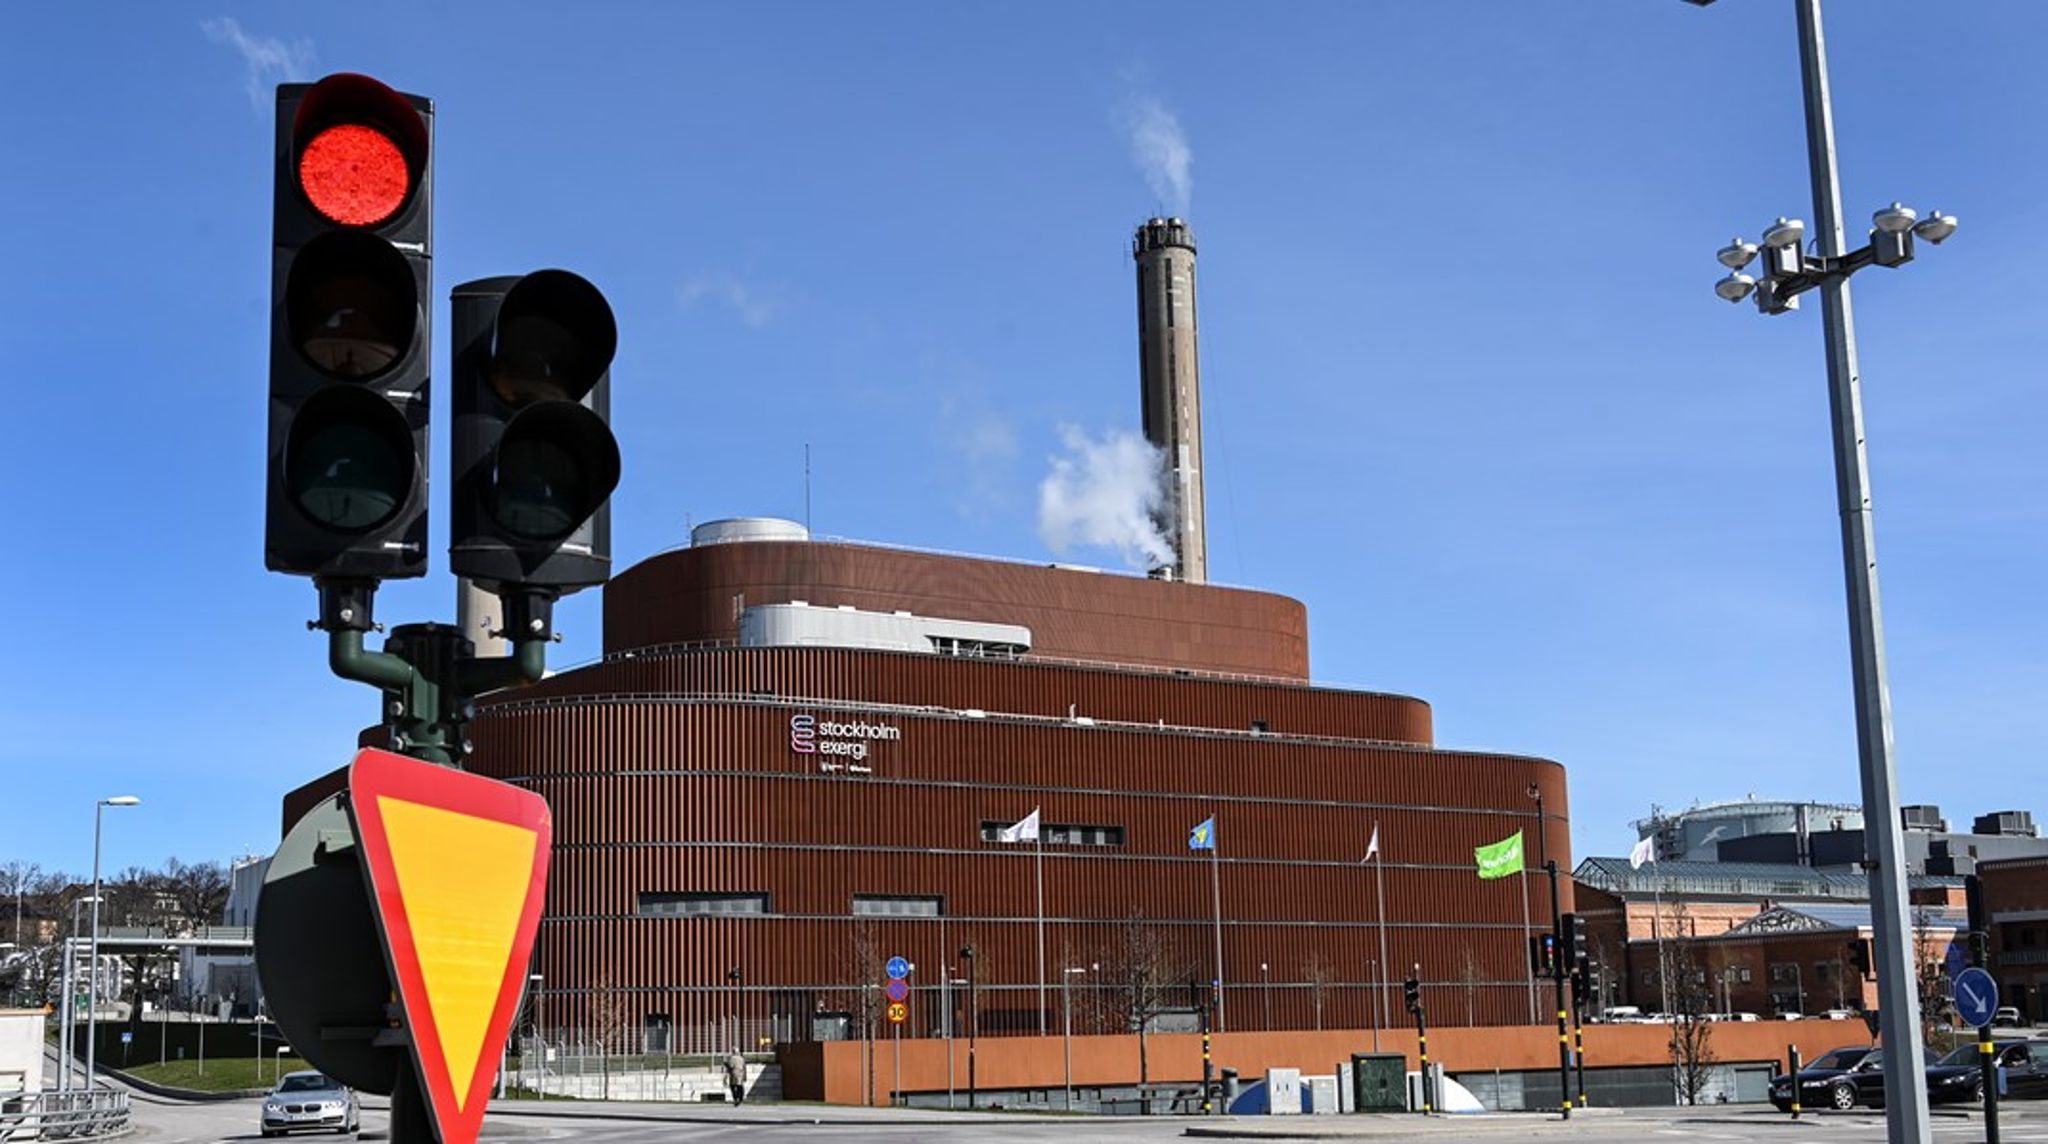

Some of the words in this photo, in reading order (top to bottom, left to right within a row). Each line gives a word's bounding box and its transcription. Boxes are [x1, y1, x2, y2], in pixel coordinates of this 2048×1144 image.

[820, 721, 899, 739] stockholm
[820, 740, 867, 759] exergi
[890, 1007, 905, 1018] 30
